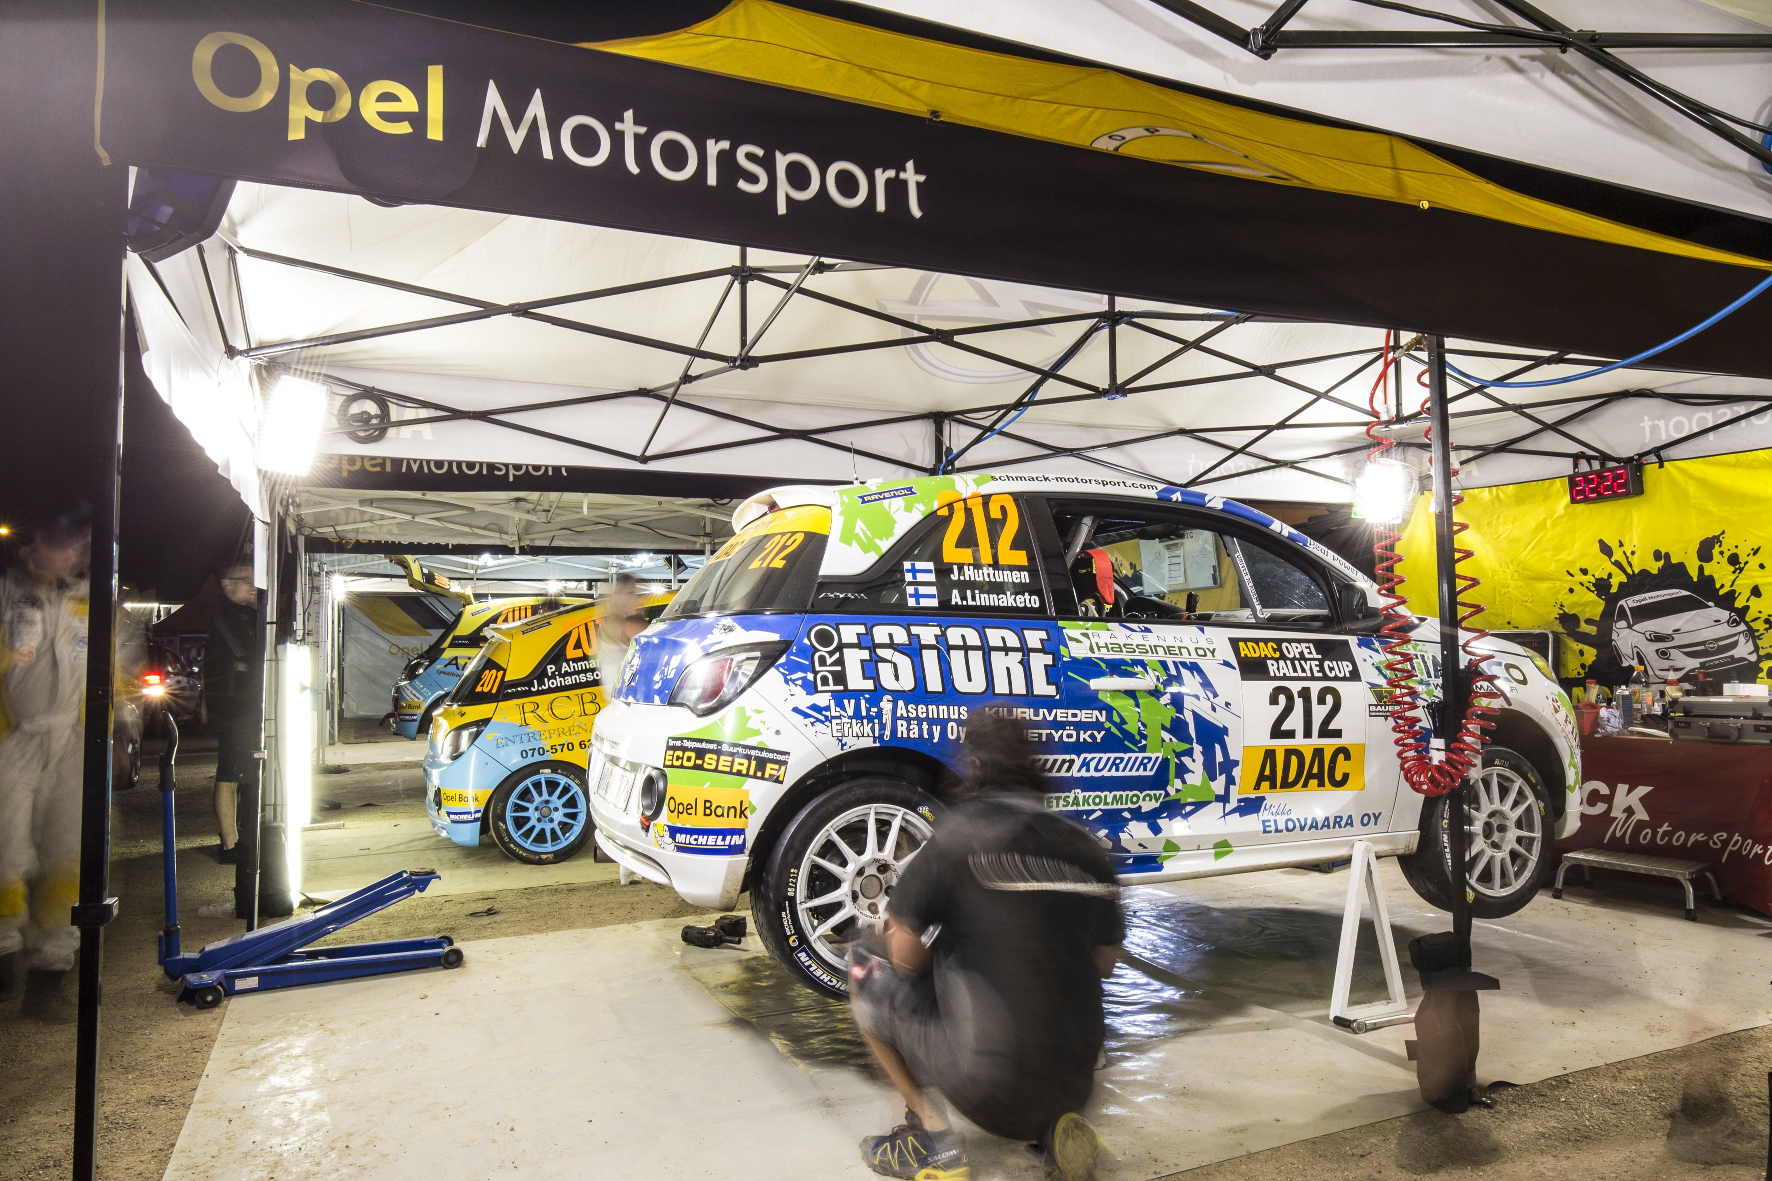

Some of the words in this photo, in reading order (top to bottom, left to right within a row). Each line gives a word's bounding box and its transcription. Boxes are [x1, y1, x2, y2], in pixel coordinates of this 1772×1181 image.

[191, 31, 444, 141] Opel
[476, 79, 927, 219] Motorsport
[991, 474, 1159, 491] schmack-motorsport.com
[1572, 469, 1627, 500] 22:22
[863, 489, 911, 503] RAVENOL
[937, 490, 1029, 566] 212
[748, 532, 805, 569] 212
[951, 565, 1030, 583] J.Huttunen
[951, 589, 1040, 608] A.Linnaketo
[1632, 596, 1649, 604] Opel
[1648, 590, 1682, 601] Motorsport
[1092, 632, 1214, 645] RAKENNUS
[388, 643, 423, 658] Opel
[1194, 647, 1217, 658] OY
[1238, 641, 1280, 658] ADAC
[1281, 642, 1322, 659] OPEL
[547, 664, 558, 677] P.
[561, 658, 600, 675] Ahma
[810, 625, 844, 692] PRO
[836, 623, 1059, 697] ESTORE
[1267, 660, 1322, 677] RALLYE
[1324, 661, 1353, 678] CUP
[475, 669, 504, 694] 201
[531, 670, 602, 692] J.Johansso
[515, 691, 600, 728] RCB
[896, 704, 968, 720] Asennus
[1268, 685, 1343, 740] 212
[832, 719, 879, 738] Erkki
[897, 720, 942, 743] Räty
[947, 722, 968, 744] Oy
[1023, 726, 1077, 742] ETYÖ
[1079, 730, 1107, 743] KY
[520, 741, 575, 760] 070-570
[664, 750, 787, 782] ECO-SERI.FI
[1031, 757, 1076, 774] run
[1077, 755, 1162, 774] KURIIRI
[1252, 746, 1352, 791] ADAC
[443, 792, 457, 803] Opel
[1046, 790, 1140, 810] ETSÄKOLMIO
[1580, 780, 1655, 821] CK
[667, 796, 698, 819] Opel
[703, 800, 748, 820] Bank
[1260, 802, 1293, 818] Mikko
[1261, 816, 1355, 835] ELOVAARA
[1360, 811, 1383, 827] OY
[675, 832, 745, 846] MICHELIN
[1603, 812, 1772, 866] Motorsport
[927, 1148, 960, 1164] SALOM
